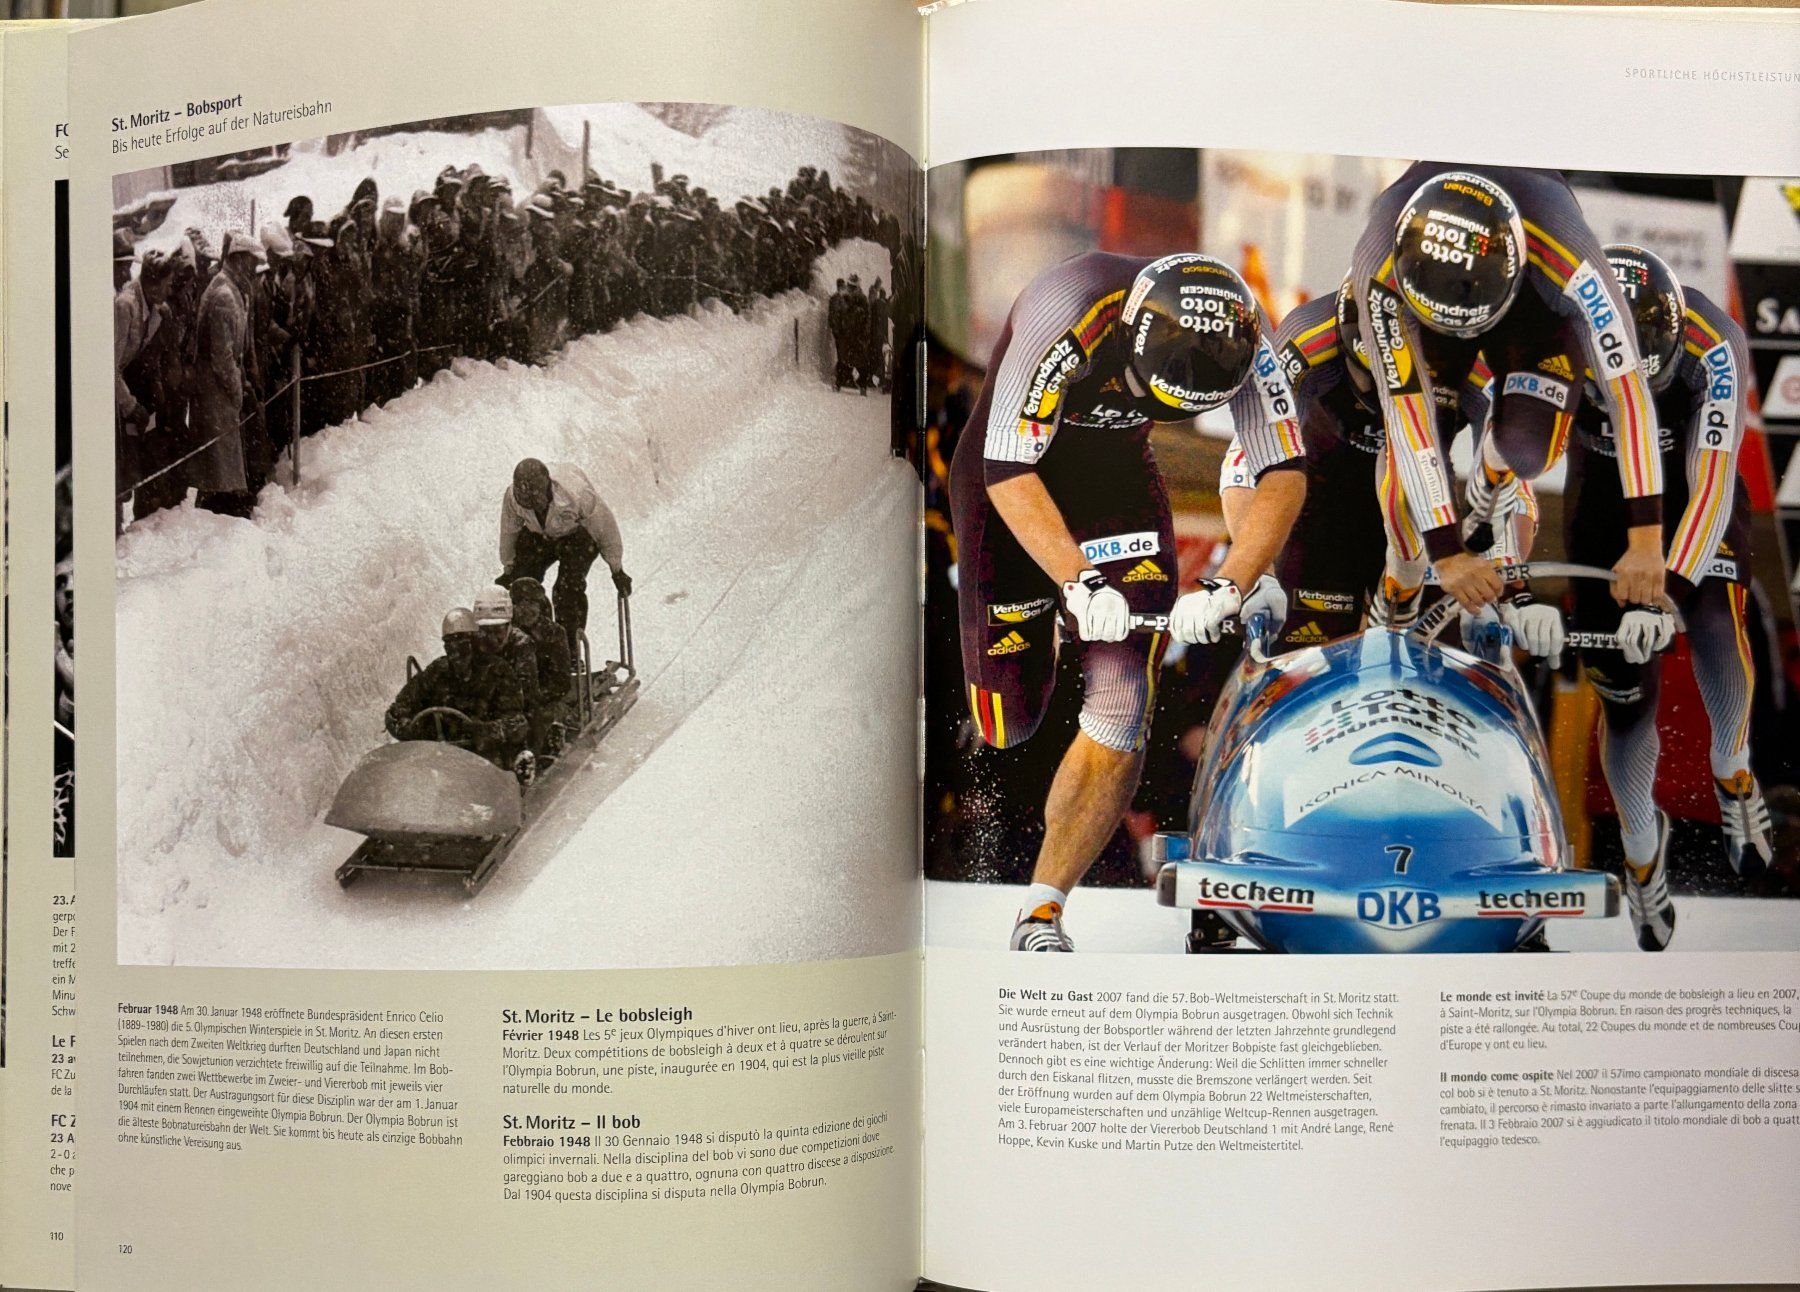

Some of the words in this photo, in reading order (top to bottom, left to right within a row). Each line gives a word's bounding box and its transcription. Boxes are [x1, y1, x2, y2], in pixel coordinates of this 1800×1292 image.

[111, 117, 128, 132] St.
[130, 109, 170, 128] Moritz
[186, 94, 242, 117] Bobsport
[112, 138, 128, 153] Bis
[131, 134, 162, 150] heute
[165, 125, 205, 143] Erfolge
[208, 117, 227, 135] auf
[230, 116, 249, 130] der
[253, 102, 331, 126] Natureisbahn
[55, 145, 69, 160] Se
[1420, 239, 1475, 271] Lotto
[1179, 286, 1244, 304] THÜRINGEN
[1180, 297, 1227, 318] Toto
[1134, 312, 1154, 356] uvex
[1179, 314, 1235, 338] Lotto
[1368, 288, 1402, 389] Verbundnetz
[1388, 319, 1405, 350] Gas
[1506, 375, 1565, 403] DKB.de
[1705, 348, 1734, 447] DKB.de
[1084, 536, 1154, 562] DKB.de
[1122, 571, 1169, 584] adidas
[987, 641, 1031, 656] adidas
[1331, 688, 1477, 729] Lotto
[1358, 700, 1478, 744] Toto
[1305, 714, 1481, 761] THÜRINGEN
[1299, 770, 1386, 813] KONICA
[1394, 766, 1490, 817] MINOLTA
[1384, 844, 1414, 876] 7
[52, 895, 69, 905] 23.
[1199, 876, 1316, 905] techem
[1478, 888, 1587, 910] techem
[1356, 889, 1443, 926] DKB
[53, 926, 68, 937] Der
[52, 942, 68, 953] mit
[52, 974, 66, 985] ein
[998, 987, 1016, 999] Die
[1020, 988, 1047, 1000] Welt
[1050, 992, 1063, 1001] zu
[1067, 990, 1093, 1001] Gast
[1096, 991, 1122, 1002] 2007
[1126, 991, 1149, 1002] fand
[1152, 992, 1168, 1003] die
[1172, 992, 1187, 1003] 57.
[1189, 992, 1307, 1003] Bob-Weltmeisterschaft
[1310, 992, 1320, 1003] in
[1323, 992, 1336, 1003] St.
[1338, 992, 1370, 1003] Moritz
[1373, 993, 1398, 1002] statt.
[1440, 991, 1453, 1002] Le
[1455, 990, 1492, 1002] monde
[1495, 991, 1511, 1001] est
[1514, 989, 1545, 1001] invité
[1546, 991, 1558, 1001] La
[1579, 989, 1611, 1001] Coupe
[1612, 989, 1626, 1000] du
[1628, 990, 1662, 999] monde
[1664, 989, 1677, 999] de
[1678, 988, 1725, 1001] bobsleigh
[1736, 988, 1755, 999] lieu
[1757, 991, 1769, 999] en
[52, 1005, 76, 1017] Schw
[117, 1002, 152, 1014] Februar
[155, 1004, 178, 1015] 1948
[180, 1004, 194, 1015] Am
[196, 1005, 207, 1016] 30.
[210, 1005, 238, 1017] Januar
[241, 1007, 262, 1018] 1948
[264, 1007, 304, 1019] eröffnete
[307, 1008, 383, 1023] Bundespräsident
[386, 1010, 416, 1022] Enrico
[419, 1010, 443, 1022] Celio
[502, 1009, 522, 1023] St.
[525, 1009, 575, 1023] Moritz
[596, 1008, 613, 1022] Le
[618, 1006, 692, 1025] bobsleigh
[502, 1028, 544, 1041] Février
[547, 1029, 579, 1041] 1948
[583, 1029, 601, 1040] Les
[620, 1028, 644, 1042] jeux
[646, 1026, 714, 1041] Olympiques
[716, 1024, 755, 1036] d'hiver
[756, 1023, 777, 1034] ont
[779, 1021, 802, 1033] lieu,
[803, 1018, 830, 1033] après
[831, 1017, 840, 1028] la
[841, 1016, 870, 1030] guerre,
[52, 1035, 66, 1047] Le
[51, 1054, 64, 1064] 23
[51, 1069, 62, 1080] FC
[51, 1086, 62, 1096] de
[51, 1115, 67, 1127] FC
[502, 1114, 522, 1129] St.
[525, 1115, 576, 1129] Moritz
[612, 1114, 640, 1128] bob
[51, 1134, 64, 1144] 23
[50, 1166, 66, 1177] che
[50, 1182, 72, 1192] nove
[503, 1187, 520, 1200] Dal
[525, 1189, 551, 1200] 1904
[554, 1190, 591, 1203] questa
[595, 1188, 648, 1203] disciplina
[651, 1187, 660, 1199] si
[663, 1187, 706, 1201] disputa
[710, 1184, 736, 1196] nella
[740, 1179, 784, 1196] Olympia
[788, 1176, 826, 1190] Bobrun.
[118, 1245, 132, 1254] 120
